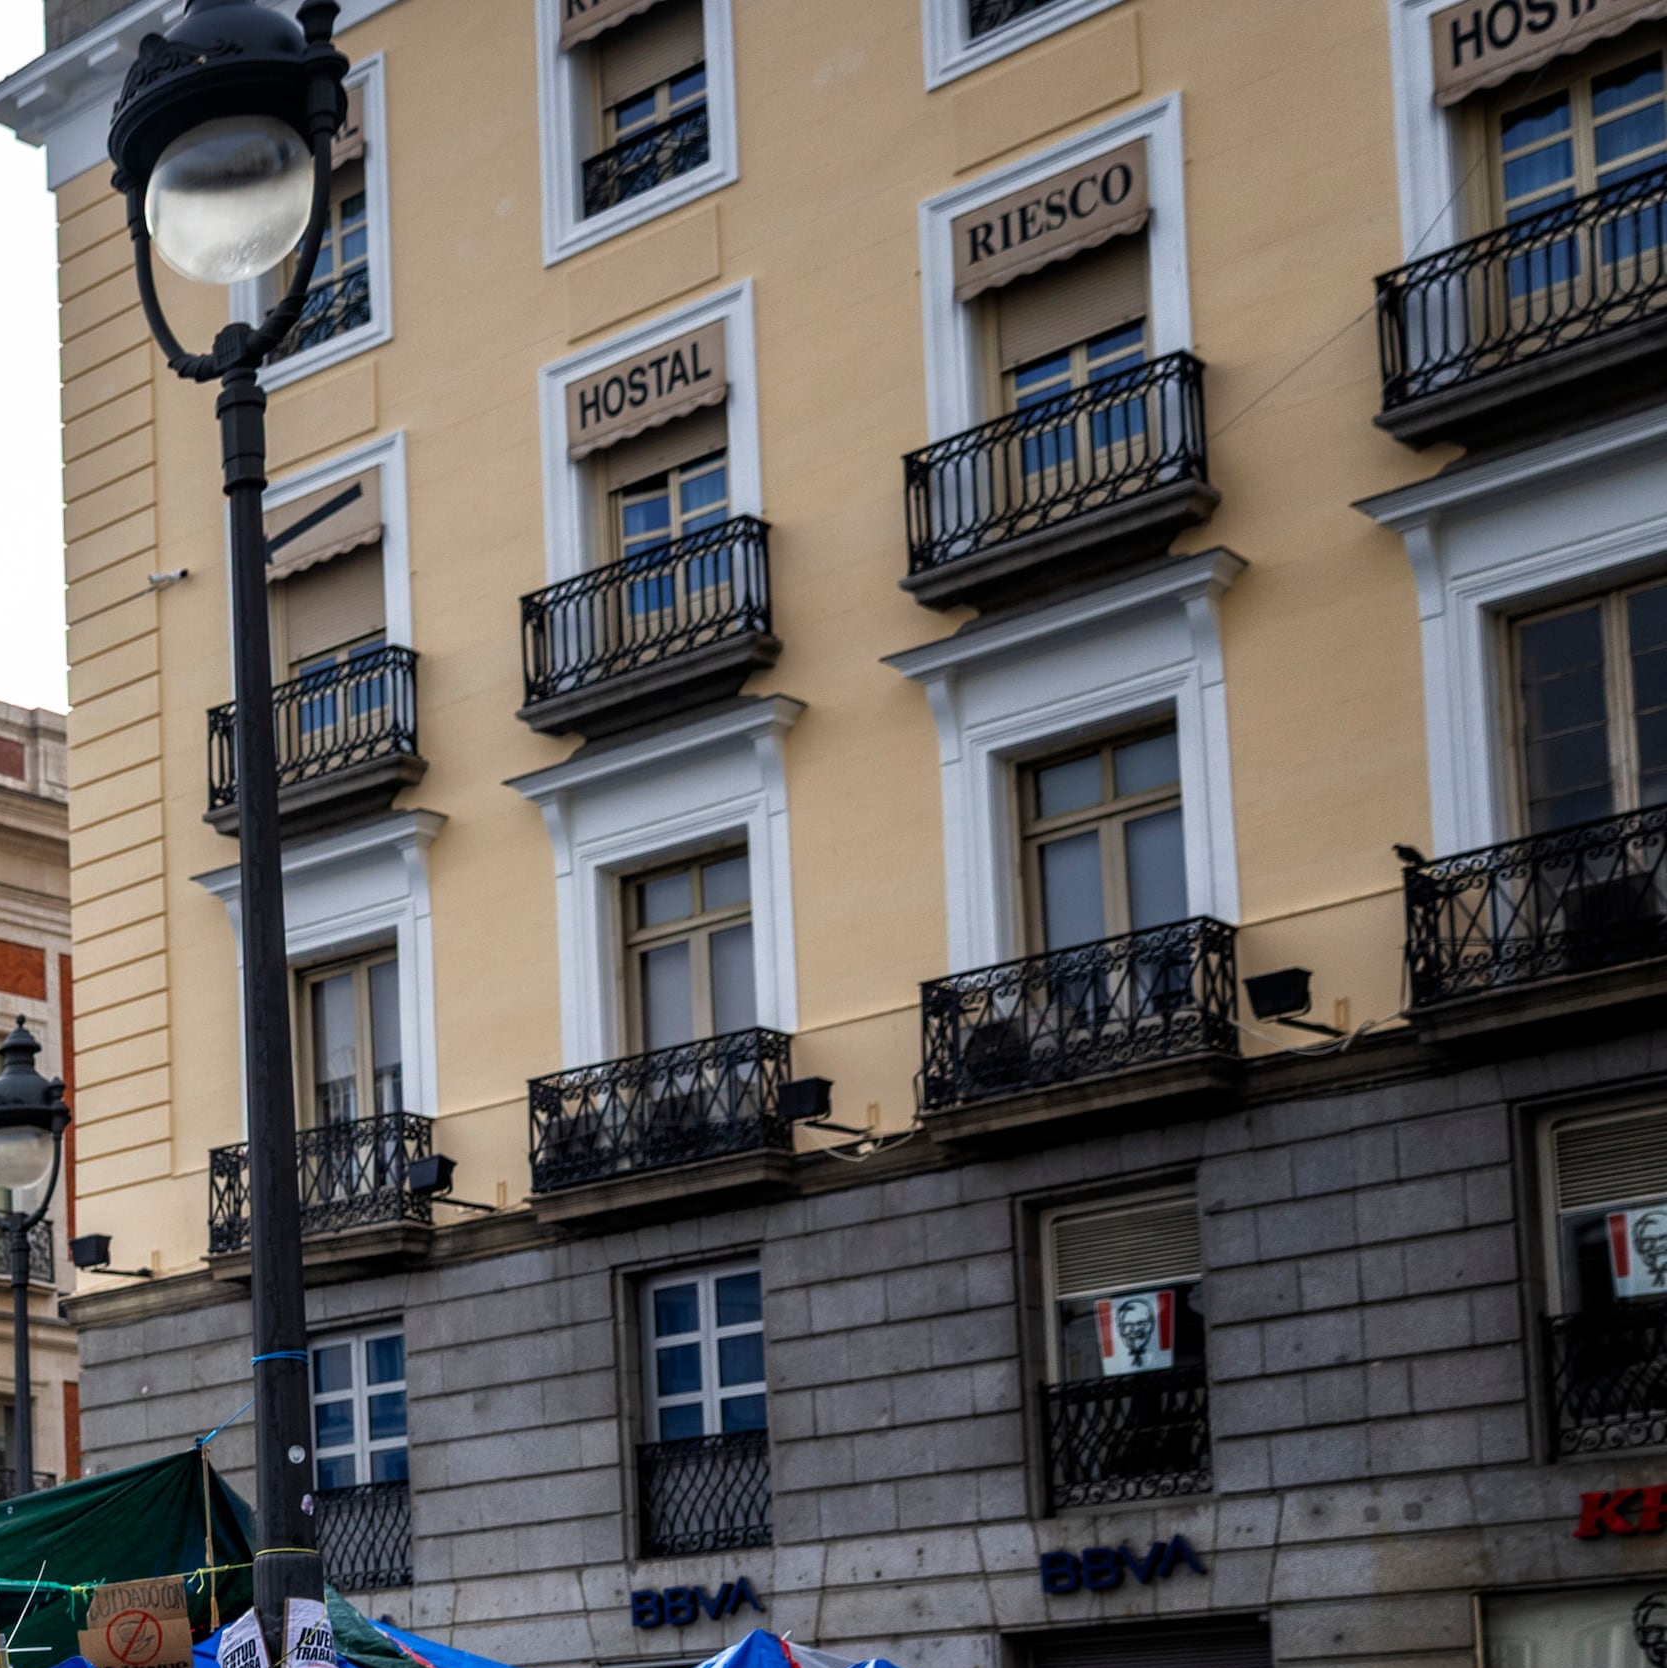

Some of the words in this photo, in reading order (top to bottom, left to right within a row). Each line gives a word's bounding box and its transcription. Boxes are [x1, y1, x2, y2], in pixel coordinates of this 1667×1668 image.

[966, 161, 1134, 267] RIESCO
[579, 341, 712, 430] HOSTAL
[630, 1576, 765, 1628] BBVA
[1040, 1534, 1207, 1595] BBVA
